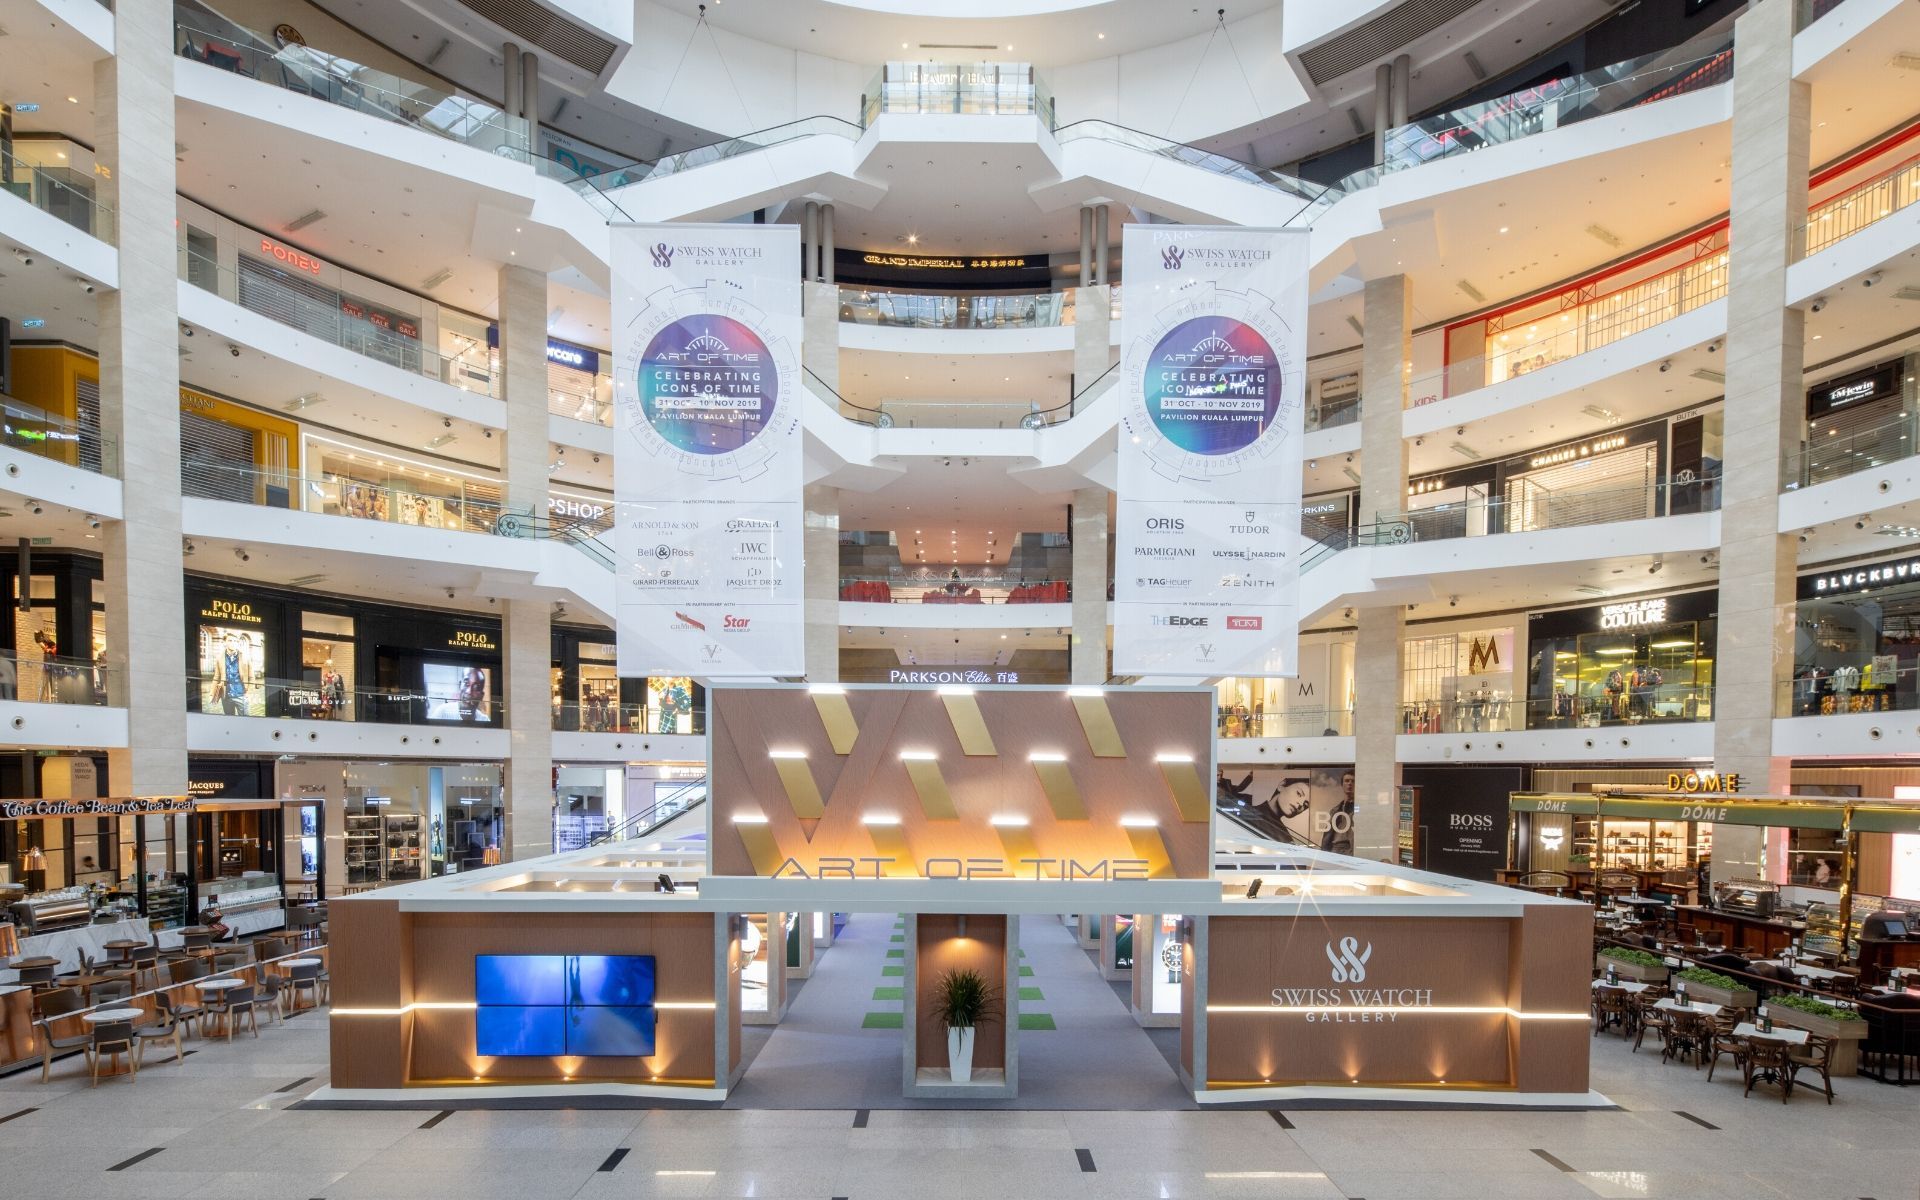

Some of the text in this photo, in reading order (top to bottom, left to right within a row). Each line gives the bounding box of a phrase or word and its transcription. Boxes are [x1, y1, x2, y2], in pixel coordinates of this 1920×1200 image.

[261, 240, 321, 275] PONEY
[677, 247, 762, 258] SWISS WATCH
[1187, 249, 1271, 260] SWISS WATCH
[863, 255, 908, 266] GRAND
[908, 258, 965, 268] IMPERIAL
[343, 306, 364, 320] SALE
[370, 316, 390, 328] SALE
[399, 326, 417, 338] SALE
[656, 352, 759, 362] ART OF TIME
[1163, 354, 1264, 364] ART OF TIME
[655, 371, 761, 381] CELEBRATING
[1161, 372, 1265, 383] CELEBRATING
[655, 383, 761, 393] ICONS OF TIME
[1233, 386, 1264, 395] TIME
[1219, 401, 1238, 409] NOV
[1414, 394, 1438, 408] KIDS
[655, 412, 761, 421] PAVILION KUALA LUMPUR
[1160, 413, 1264, 423] PAVILION KUALA LUMPUR
[1676, 409, 1699, 421] BUTIK
[1530, 448, 1576, 468] CHARLES
[1580, 445, 1589, 456] &
[1593, 436, 1626, 452] KEITH
[631, 520, 699, 529] ARNOLD & SON
[726, 519, 780, 529] GRAHAM
[1146, 518, 1185, 530] ORIS
[1229, 525, 1270, 534] TUDOR
[637, 548, 654, 557] Bell
[672, 549, 695, 557] Ross
[741, 542, 767, 554] IWC
[1134, 547, 1195, 557] PARMIGIANI
[1212, 550, 1245, 558] ULYSSE
[632, 578, 699, 586] GIRARD-PERREGAUX
[726, 578, 782, 587] JAQUET DROZ
[1222, 579, 1275, 587] ZENITH
[212, 599, 251, 616] POLO
[201, 609, 262, 623] RALPH LAUREN
[723, 614, 750, 628] Star
[1601, 607, 1667, 629] COUTURE
[448, 639, 469, 647] RALPH
[456, 631, 488, 644] POLO
[890, 670, 992, 684] PARKSON Elite
[188, 780, 225, 791] JACQUES
[3, 799, 196, 819] The Coffee Bean & Tea Leaf
[1315, 811, 1354, 834] BO
[1450, 813, 1493, 827] BOSS
[771, 858, 1149, 881] ART OF TIME
[1271, 988, 1433, 1008] SWISS WATCH
[1305, 1012, 1398, 1023] GALLERY
